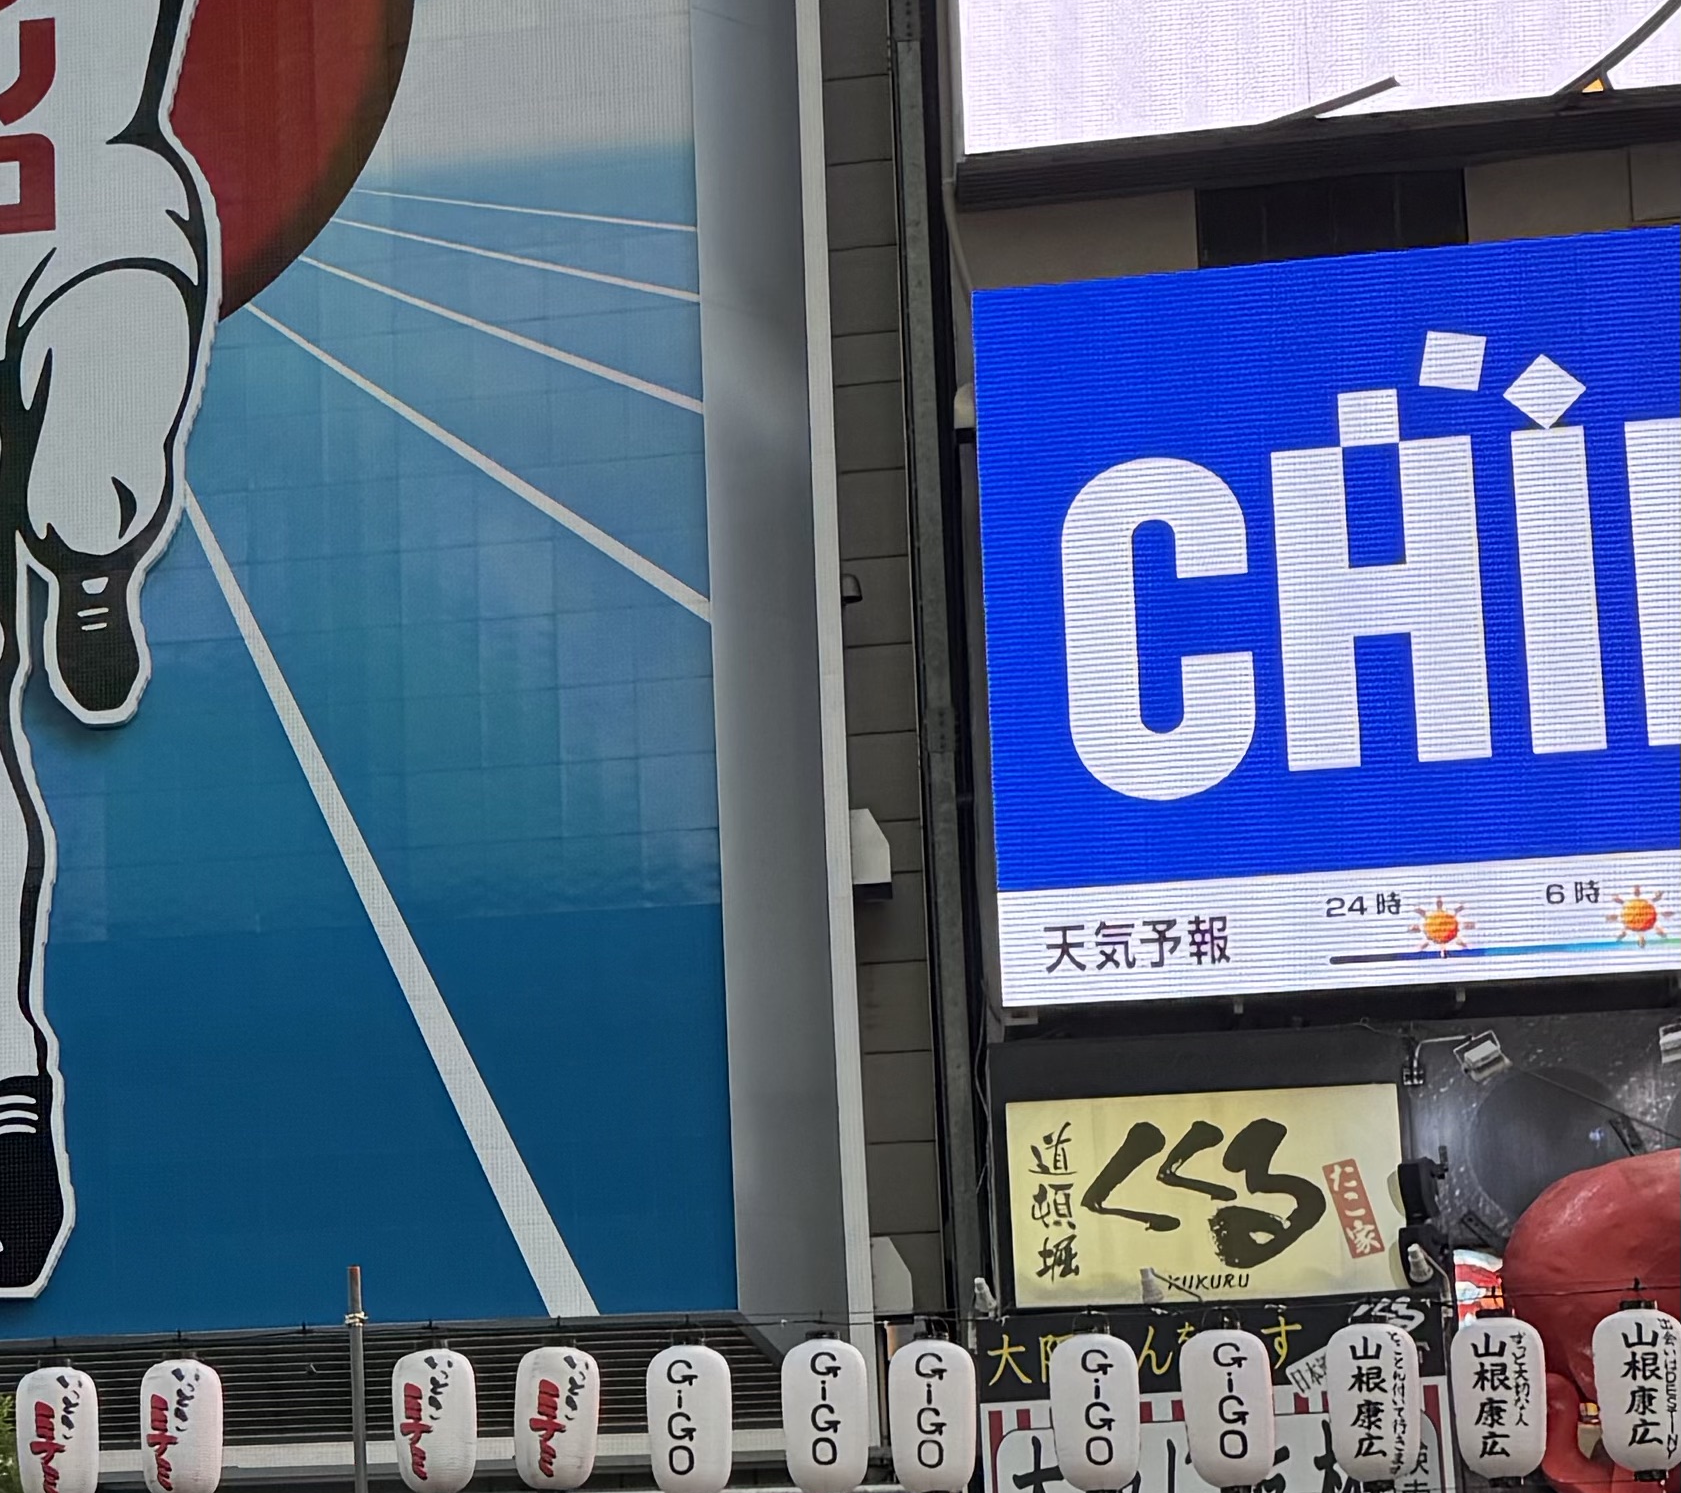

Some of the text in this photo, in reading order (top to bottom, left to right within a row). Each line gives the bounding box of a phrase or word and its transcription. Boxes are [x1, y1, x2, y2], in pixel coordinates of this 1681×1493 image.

[1043, 915, 1232, 974] 天気予報
[1028, 1120, 1081, 1284] 道頓堀
[1080, 1117, 1327, 1269] くくる
[1348, 1336, 1389, 1459] 山根康広
[1470, 1332, 1513, 1459] 山根康広
[1620, 1321, 1664, 1447] 山根康広
